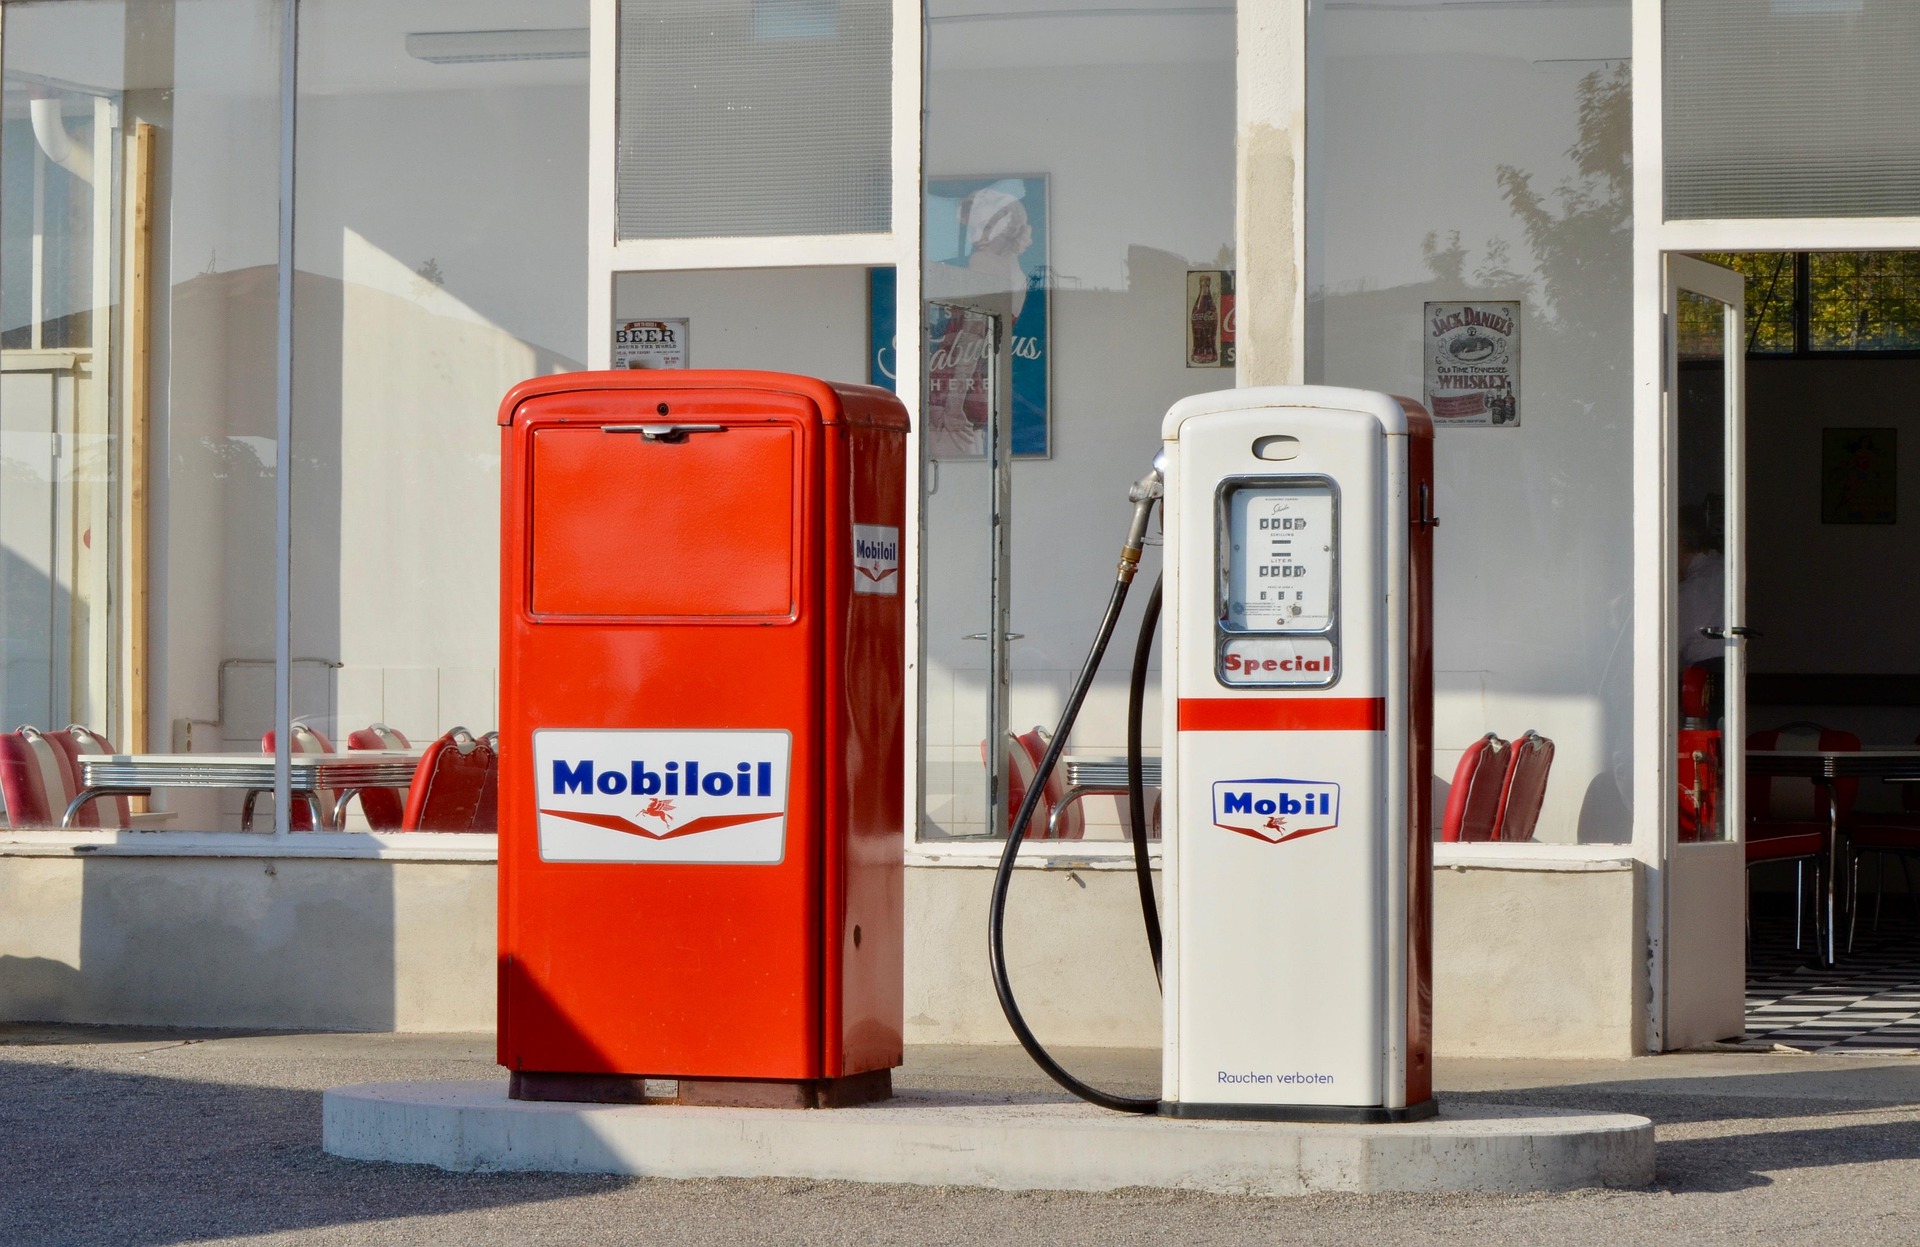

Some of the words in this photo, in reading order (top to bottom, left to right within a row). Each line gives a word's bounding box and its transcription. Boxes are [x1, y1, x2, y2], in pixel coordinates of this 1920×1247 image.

[1431, 311, 1464, 337] JACK
[1463, 306, 1514, 337] DANIEL'S
[616, 329, 675, 343] BEER
[1452, 366, 1469, 374] TIME
[1470, 366, 1508, 374] TENNESSEE
[930, 378, 989, 391] HERE
[1437, 374, 1510, 390] WHISKEY
[856, 539, 896, 561] Mobiloil
[1224, 653, 1331, 676] Special
[552, 759, 772, 797] Mobiloil
[1223, 792, 1330, 816] Mobil
[1217, 1070, 1273, 1084] Rauchen
[1276, 1071, 1335, 1084] verboten
